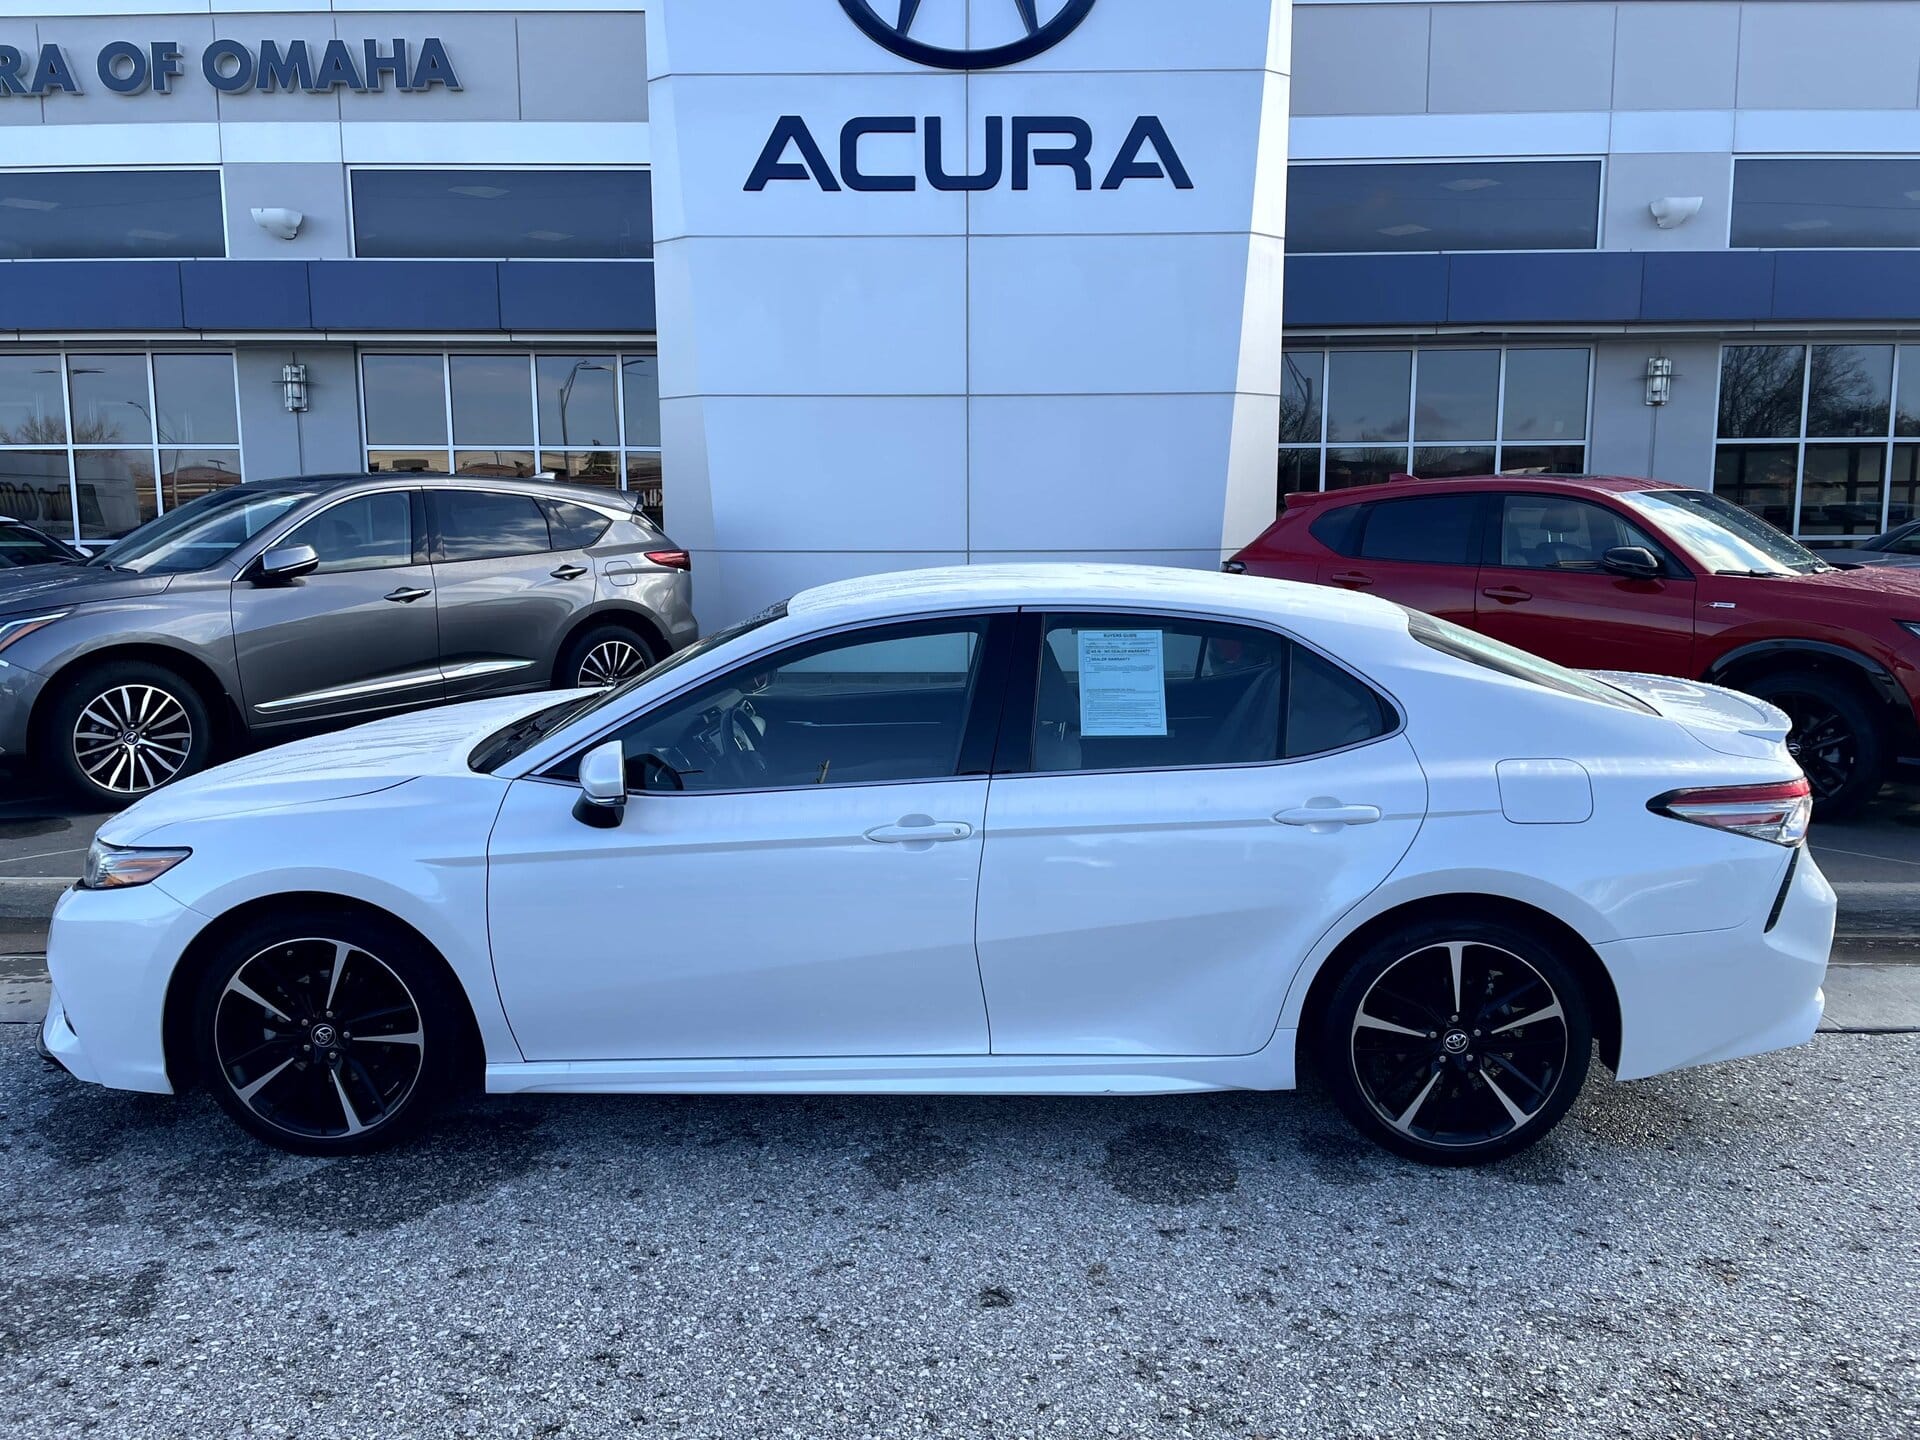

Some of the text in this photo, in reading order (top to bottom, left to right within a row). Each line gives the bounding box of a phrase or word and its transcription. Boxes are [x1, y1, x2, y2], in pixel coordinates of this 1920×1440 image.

[96, 40, 184, 94] OF
[201, 37, 463, 94] OMAHA
[743, 115, 1194, 191] ACURA
